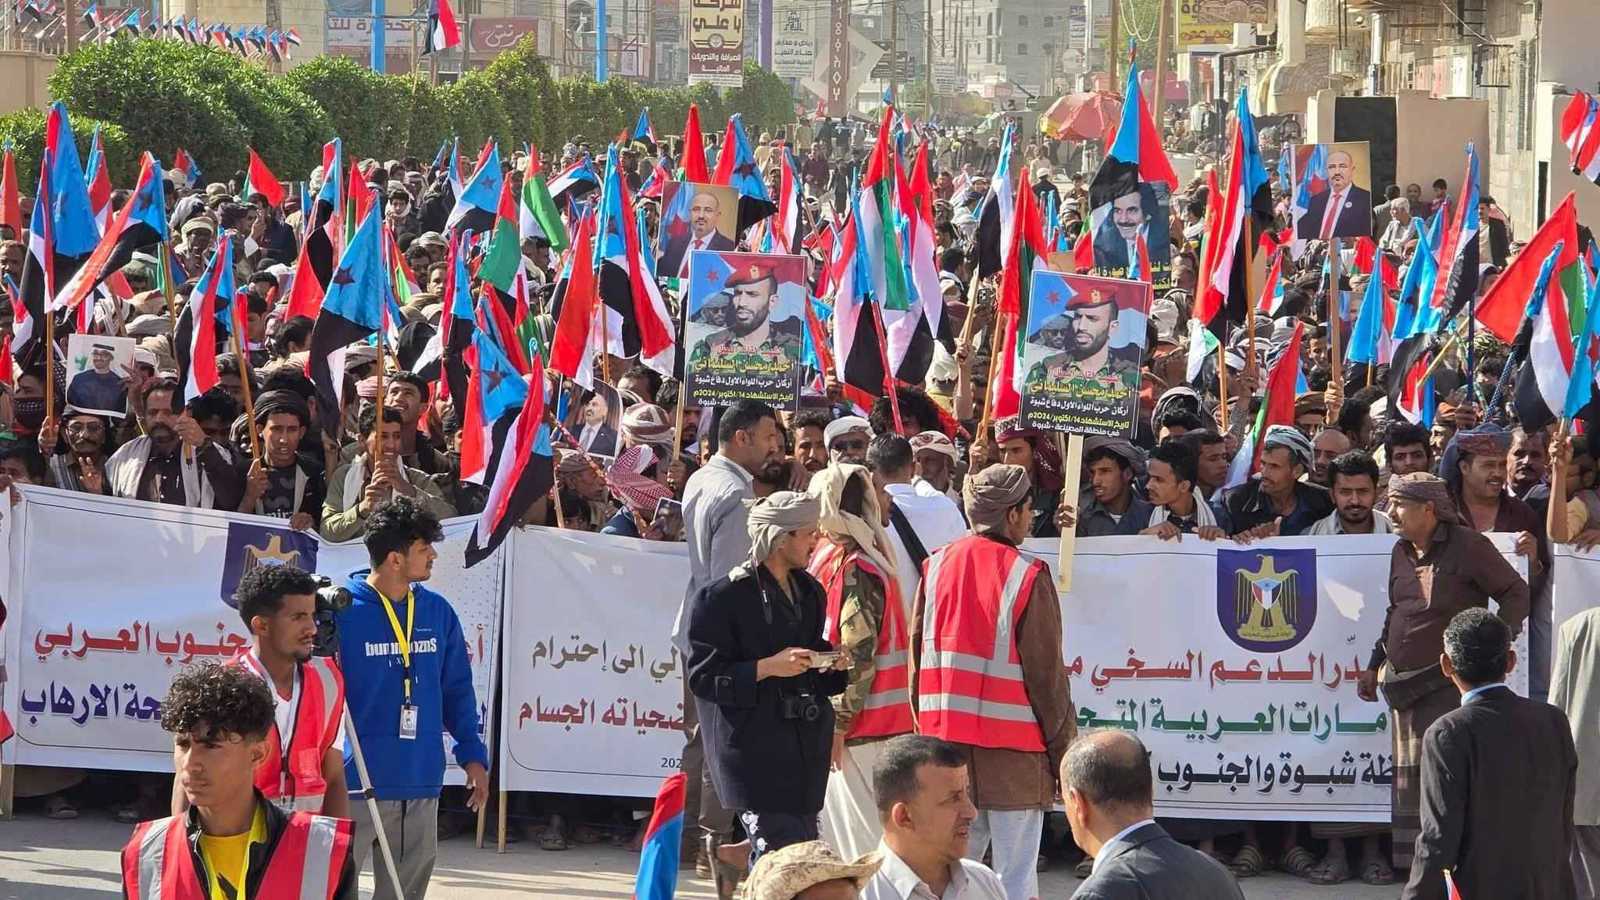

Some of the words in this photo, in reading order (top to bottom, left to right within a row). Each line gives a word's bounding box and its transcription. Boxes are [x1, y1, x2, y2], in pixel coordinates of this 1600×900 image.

[758, 378, 775, 389] حرب
[1029, 396, 1047, 407] شبوة
[1031, 420, 1051, 431] شبوة
[1093, 403, 1111, 415] حرب
[34, 620, 151, 663] العربي
[155, 622, 252, 665] جنوب
[532, 634, 608, 672] إحترام
[612, 643, 644, 674] الى
[1063, 655, 1083, 678] م
[1090, 648, 1202, 695] السخي
[1210, 650, 1325, 690] الدعم
[20, 679, 119, 726] الارهاب
[124, 682, 161, 721] حة
[518, 695, 596, 733] الجسام
[601, 696, 686, 736] ضحياته
[1076, 697, 1147, 731] المتح
[1151, 697, 1285, 741] العربية
[1289, 700, 1389, 741] مارات
[1156, 751, 1276, 795] والجنوب
[1279, 750, 1358, 795] شبوة
